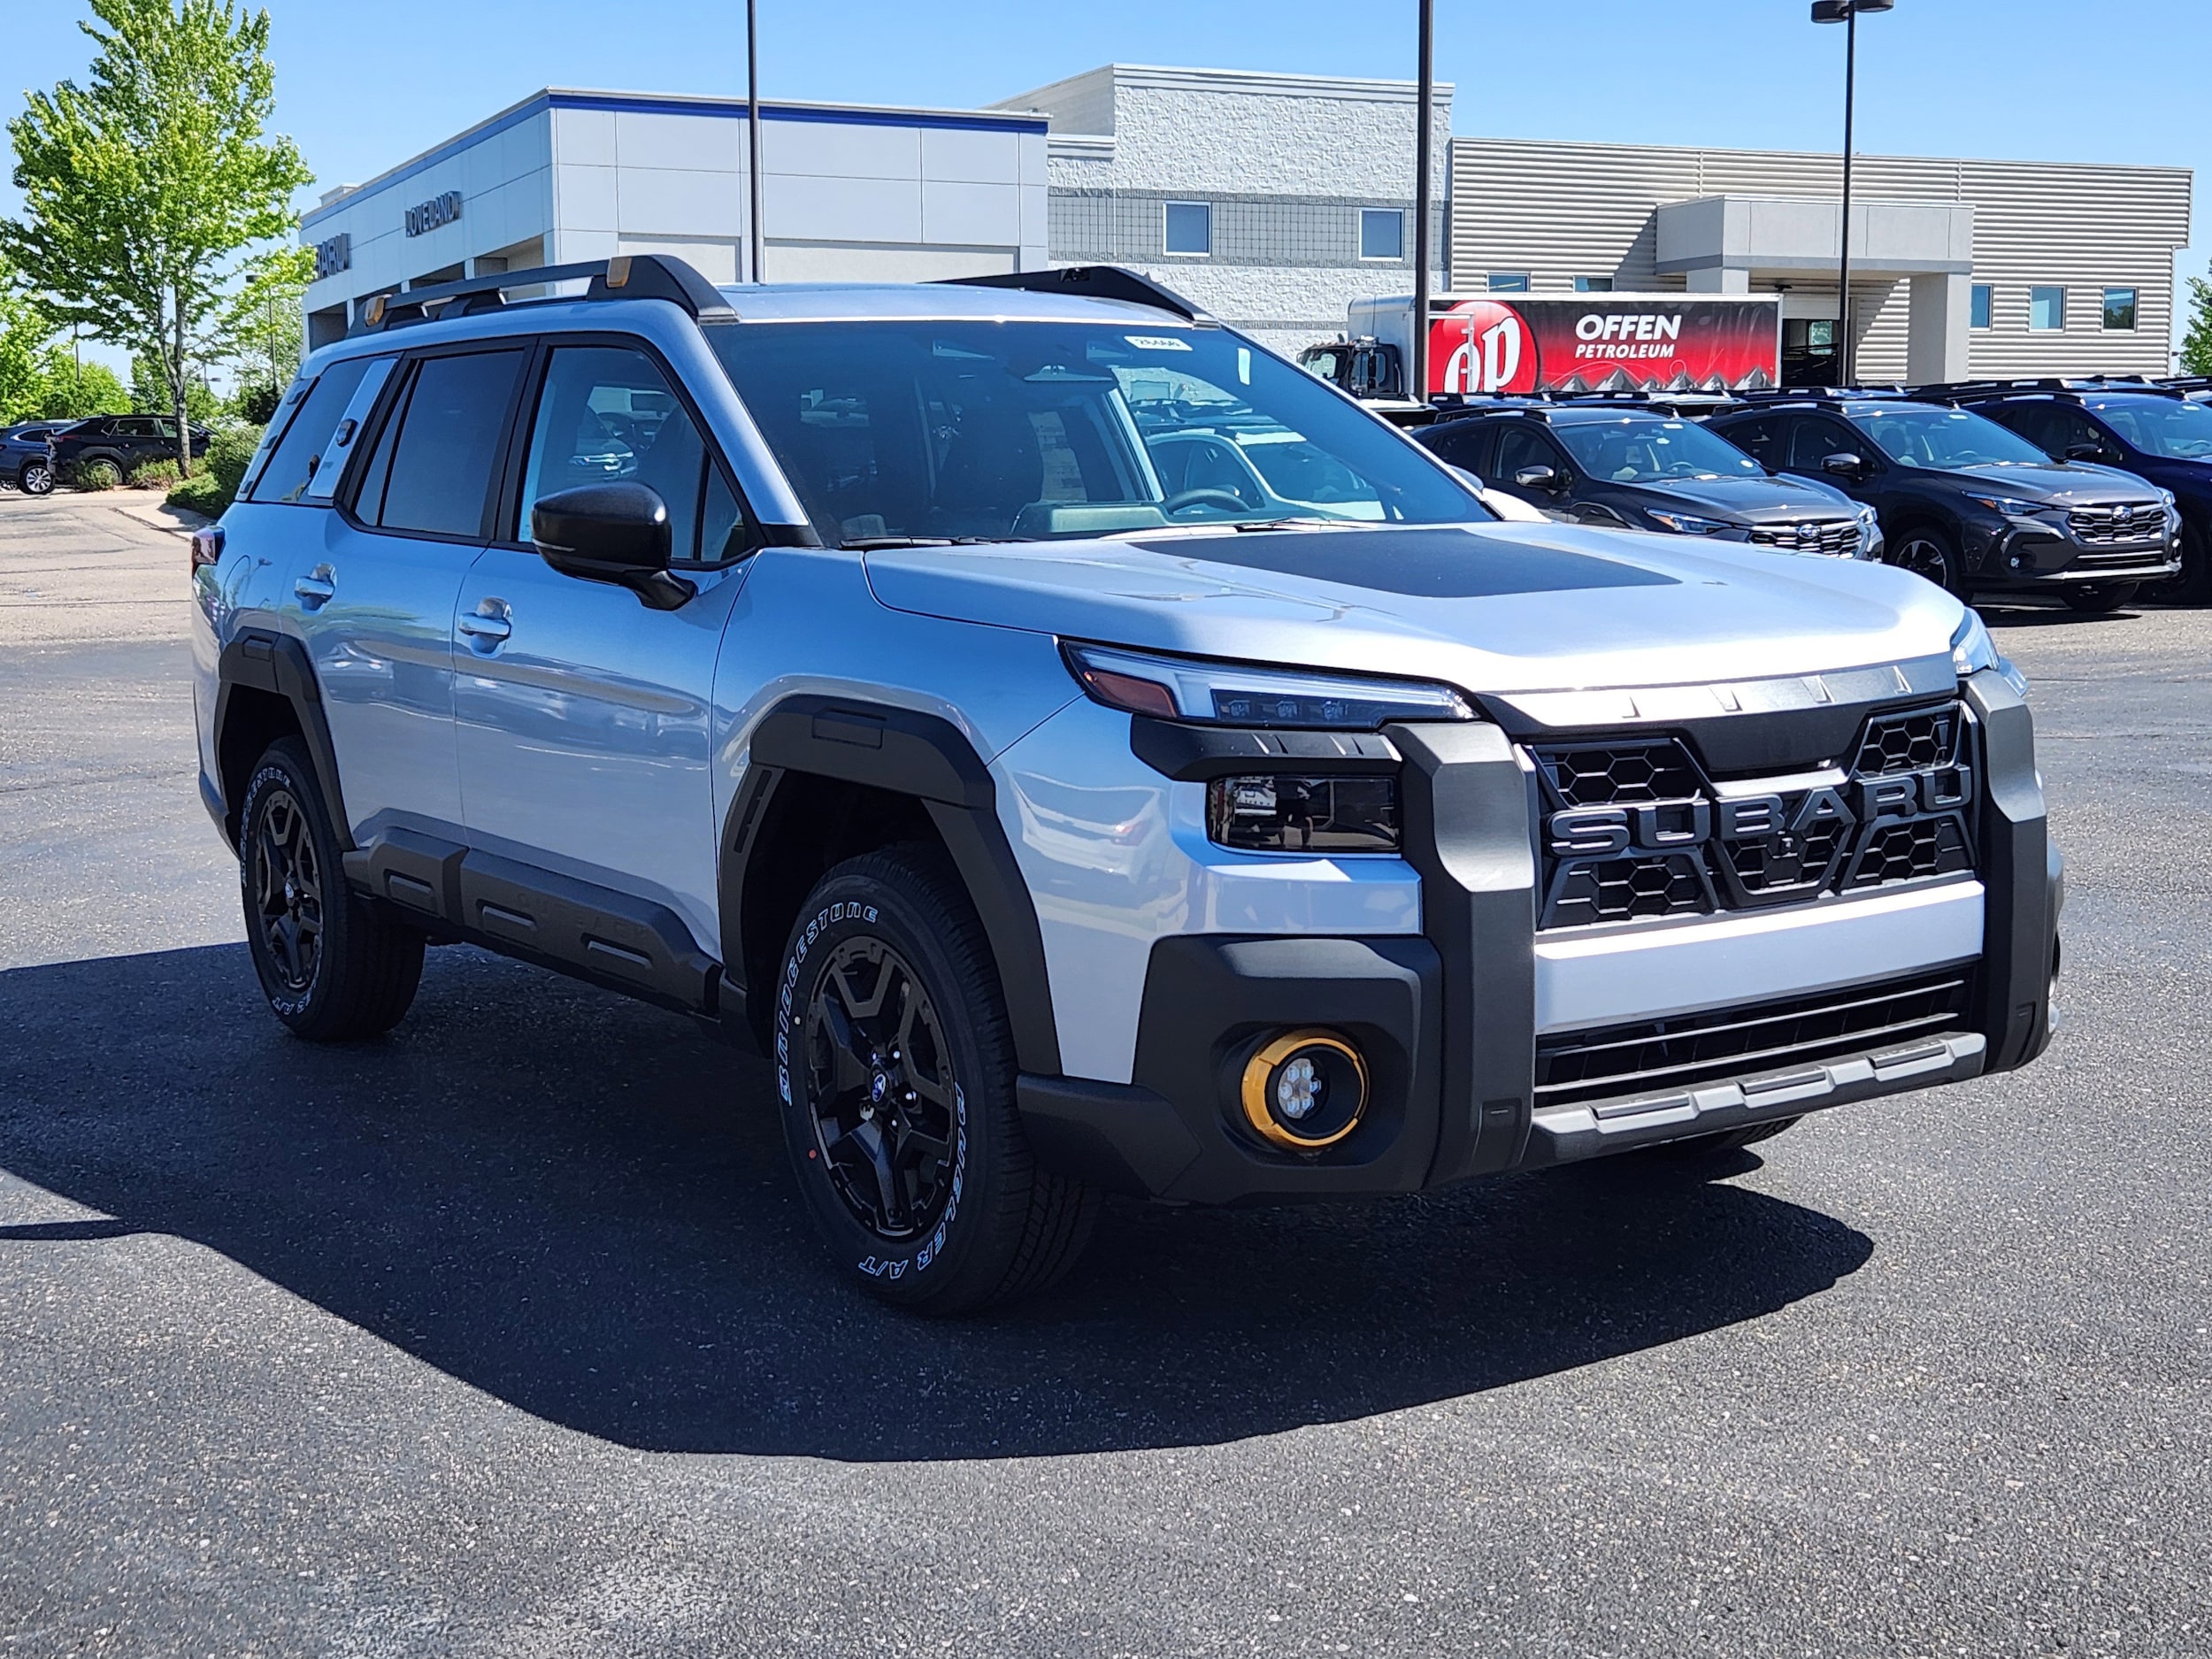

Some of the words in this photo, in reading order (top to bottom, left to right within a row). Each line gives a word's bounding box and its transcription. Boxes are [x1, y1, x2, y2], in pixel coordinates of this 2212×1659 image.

[405, 191, 462, 237] LOVELAND
[1575, 314, 1681, 342] OFFEN
[1575, 344, 1674, 359] PETROLEUM
[1550, 764, 1972, 856] SUBARU
[777, 901, 879, 1107] BRIDGESTONE
[917, 1080, 967, 1272] DUELER
[858, 1256, 910, 1279] A/T
